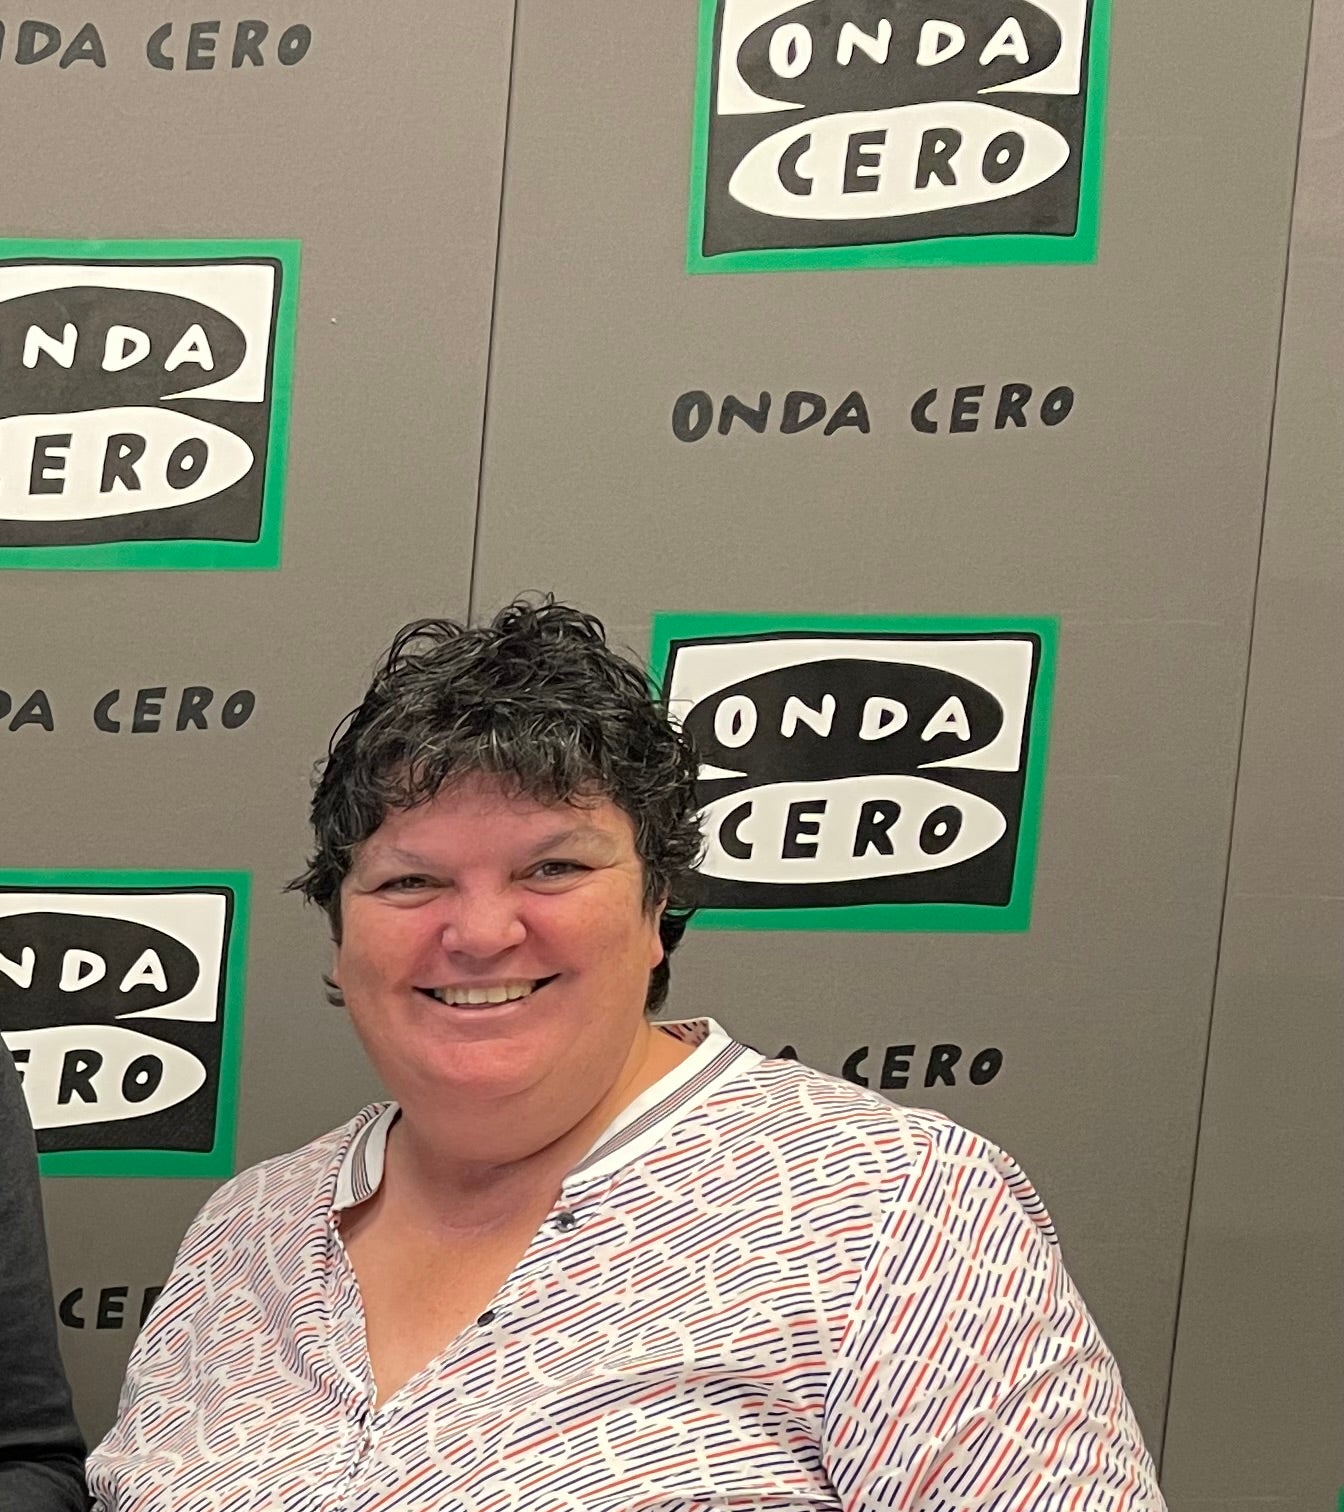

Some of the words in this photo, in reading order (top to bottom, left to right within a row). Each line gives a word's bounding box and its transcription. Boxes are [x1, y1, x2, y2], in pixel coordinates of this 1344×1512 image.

[146, 20, 312, 70] CERO
[768, 17, 1030, 78] ONDA
[777, 127, 1025, 196] CERO
[671, 390, 870, 442] ONDA
[911, 382, 1074, 434] CERO
[93, 685, 256, 734] CERO
[714, 694, 971, 748] ONDA
[719, 800, 963, 859] CERO
[842, 1044, 1003, 1089] CERO
[59, 1286, 164, 1330] CE
